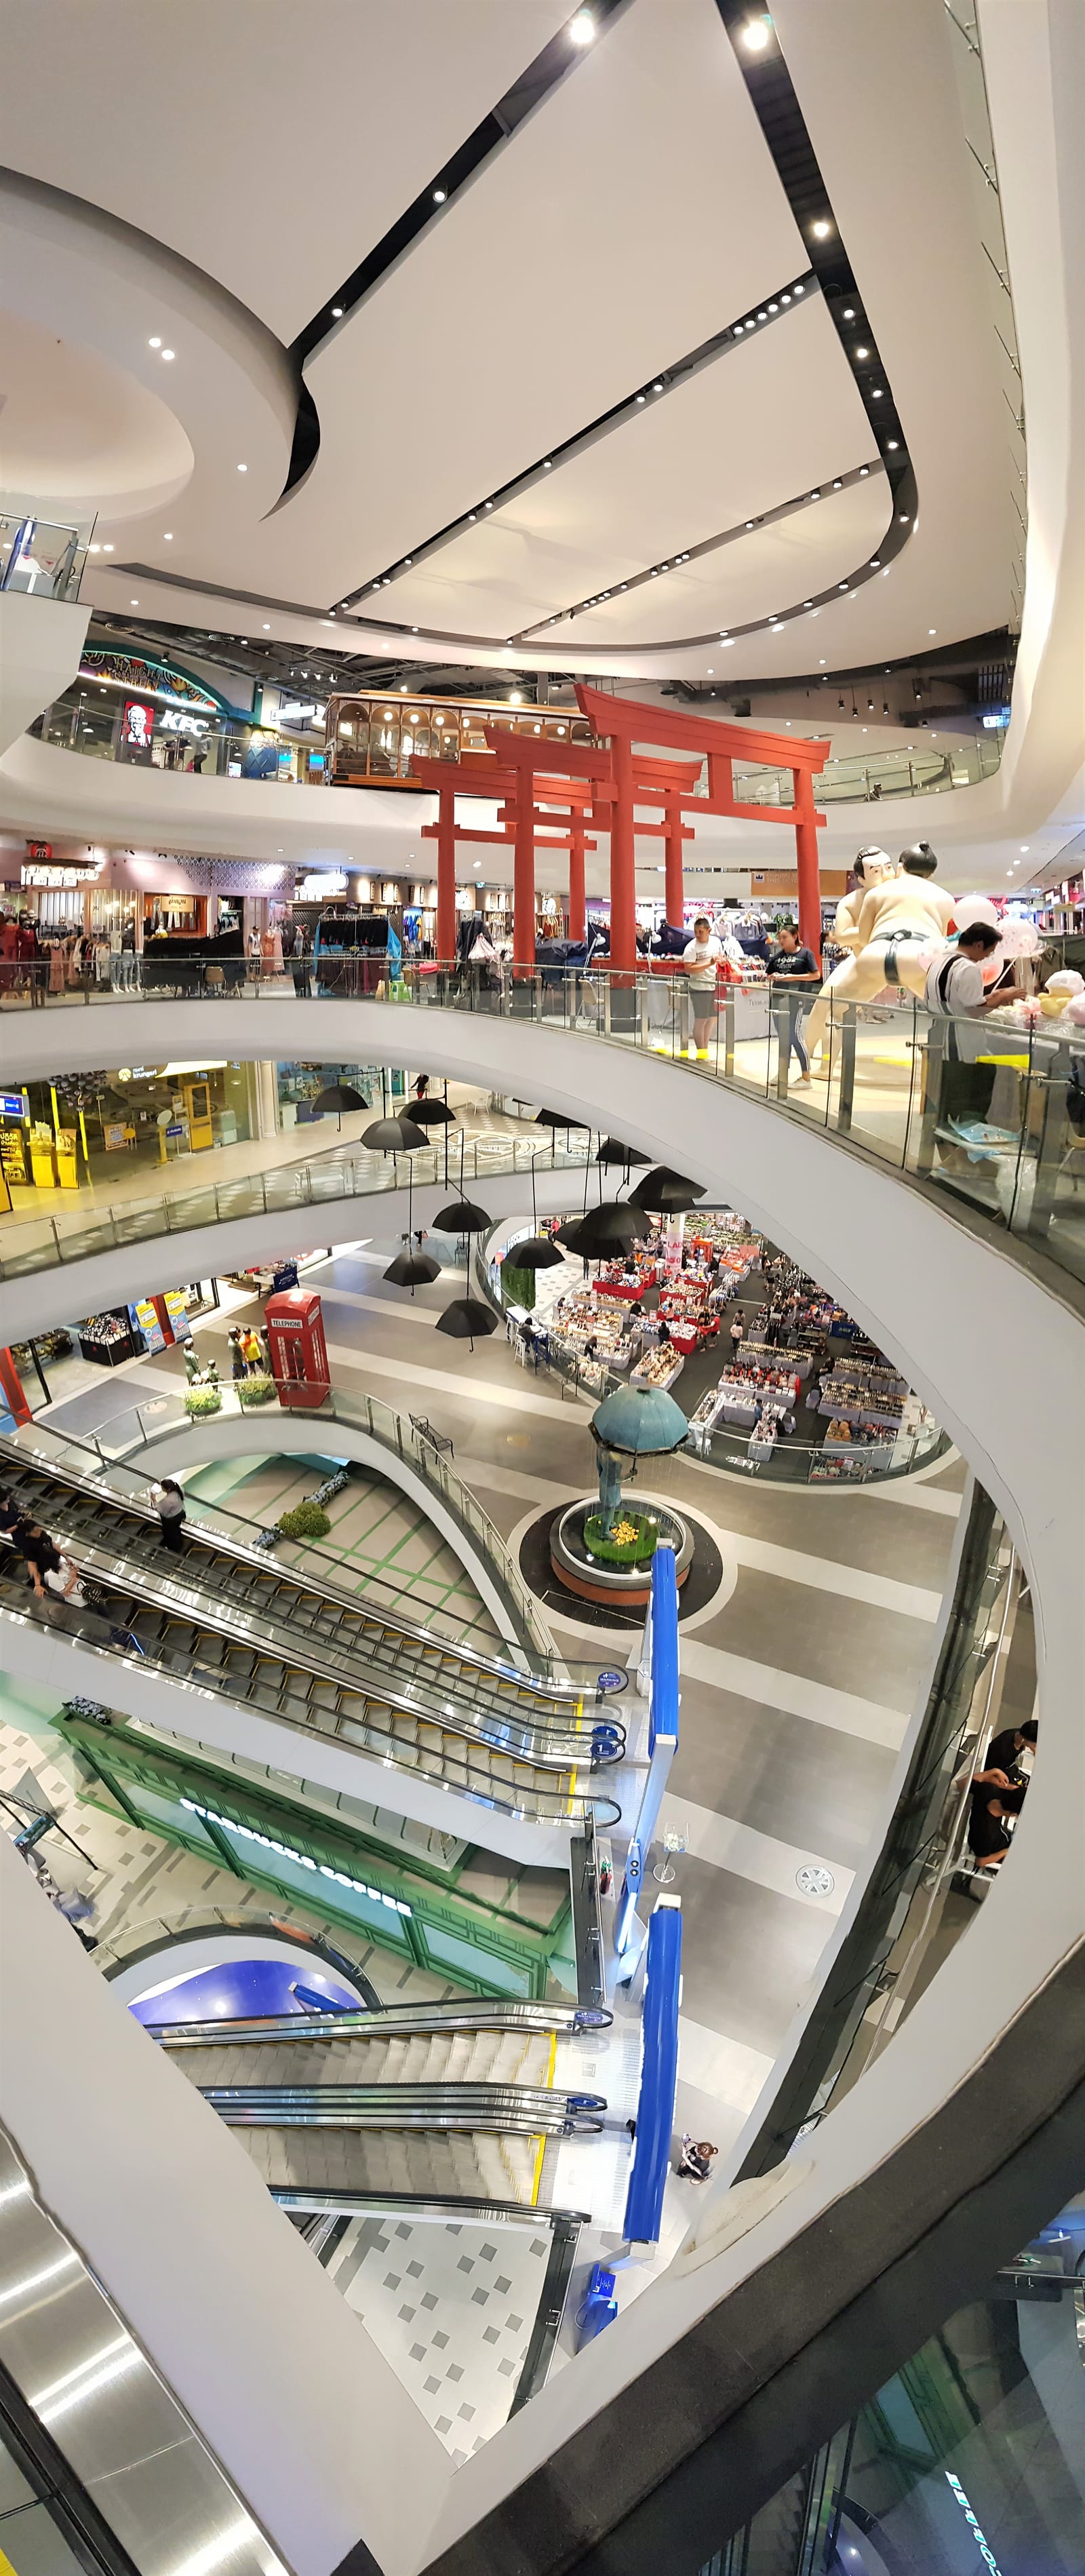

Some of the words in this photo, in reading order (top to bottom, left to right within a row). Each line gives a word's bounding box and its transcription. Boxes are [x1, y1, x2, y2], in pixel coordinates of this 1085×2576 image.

[159, 709, 205, 737] KFC
[179, 1797, 317, 1870] STARBUCKS
[319, 1865, 412, 1917] COFFEE
